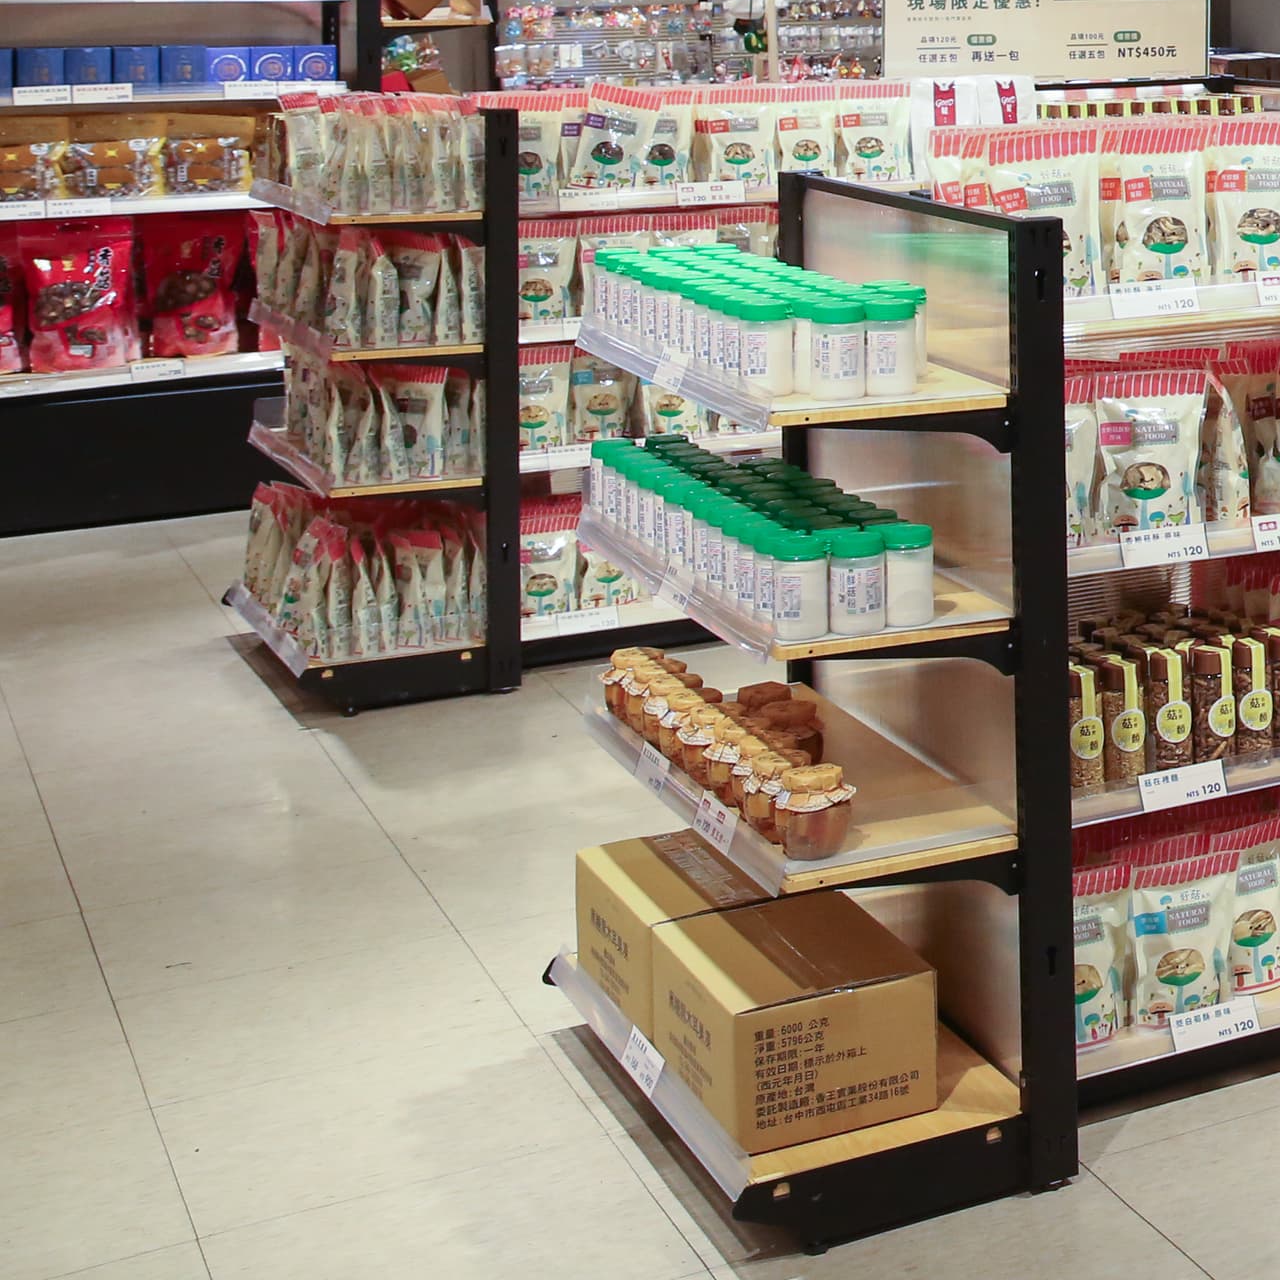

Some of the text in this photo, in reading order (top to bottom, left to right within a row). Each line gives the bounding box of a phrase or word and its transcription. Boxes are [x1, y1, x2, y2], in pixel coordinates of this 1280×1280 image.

[971, 50, 1020, 63] 再送一包
[1174, 298, 1194, 309] 120
[1183, 545, 1203, 556] 120
[1202, 783, 1221, 794] 120
[1073, 921, 1097, 932] TURAL
[754, 1017, 830, 1041] 重量:6000 公克
[1234, 1020, 1254, 1032] 120
[755, 1043, 825, 1067] 保存期限:一年
[755, 1046, 867, 1079] 有效日期:標示於外箱上
[756, 1070, 818, 1092] (西元年月日)
[755, 1083, 815, 1105] 原產地:台灣
